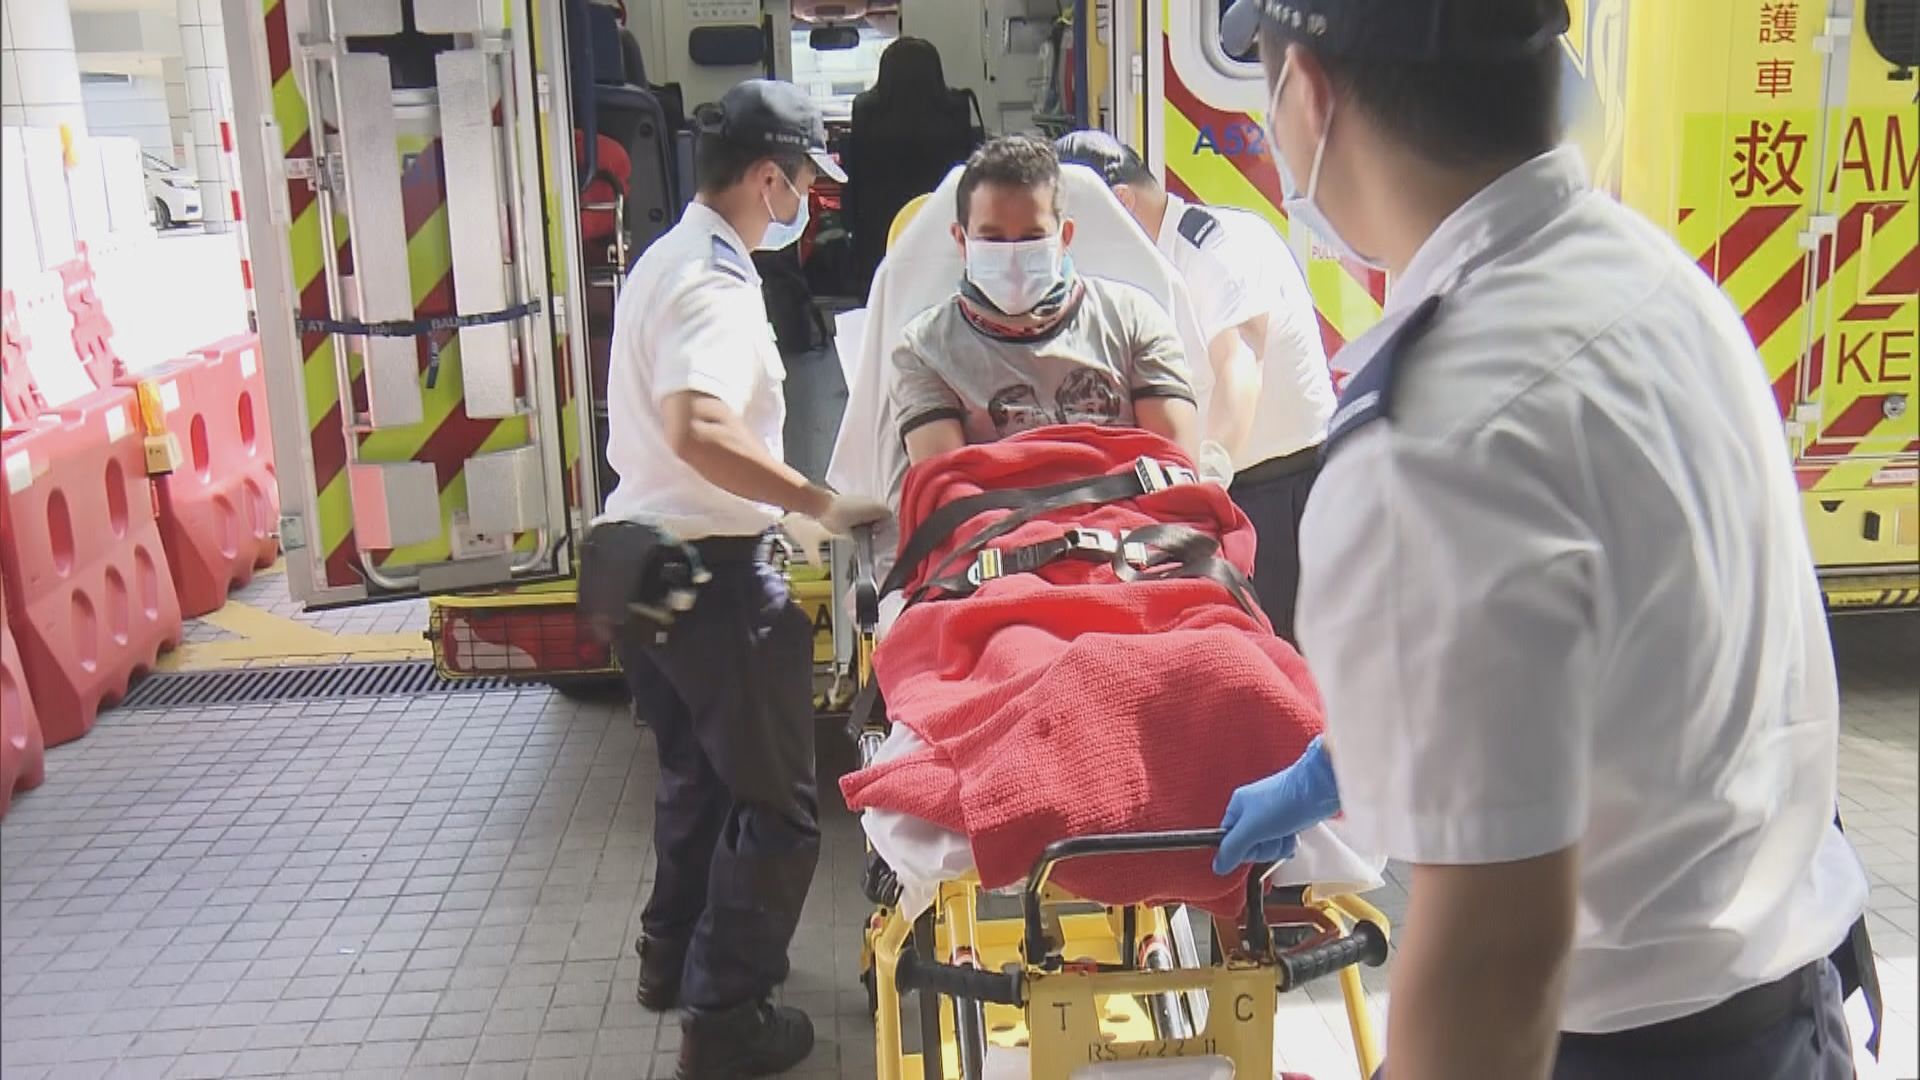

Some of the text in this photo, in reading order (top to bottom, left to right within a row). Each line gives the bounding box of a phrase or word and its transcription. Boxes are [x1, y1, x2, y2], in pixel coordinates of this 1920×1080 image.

[1729, 119, 1808, 199] 救
[1827, 114, 1919, 194] AM
[1836, 330, 1915, 385] KE
[1052, 993, 1255, 1032] T C
